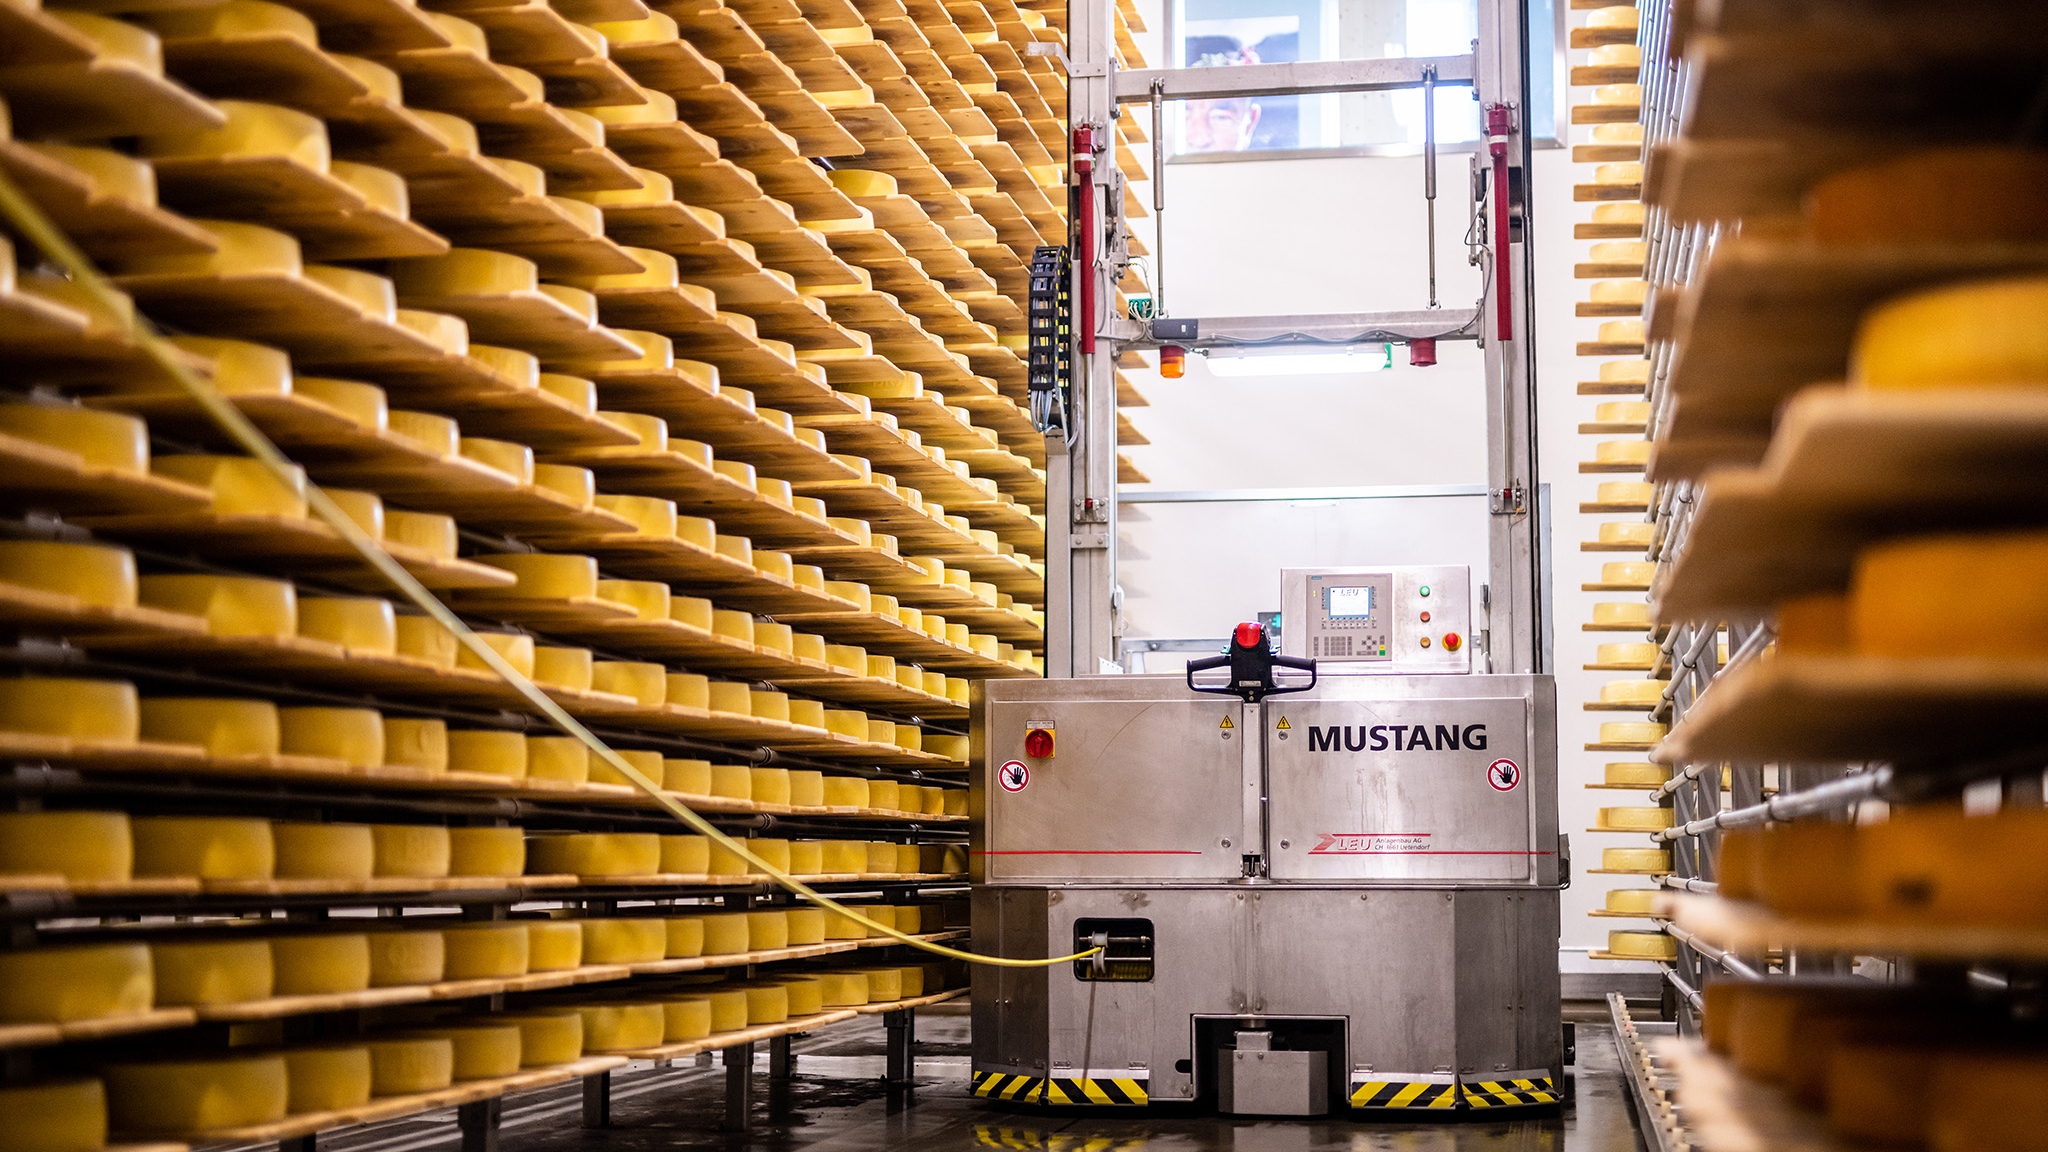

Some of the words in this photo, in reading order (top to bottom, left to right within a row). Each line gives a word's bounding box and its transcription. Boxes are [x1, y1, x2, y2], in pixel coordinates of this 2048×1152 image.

[1308, 723, 1488, 752] MUSTANG
[1338, 838, 1372, 851] LEU
[1375, 837, 1412, 846] Anlagenbau
